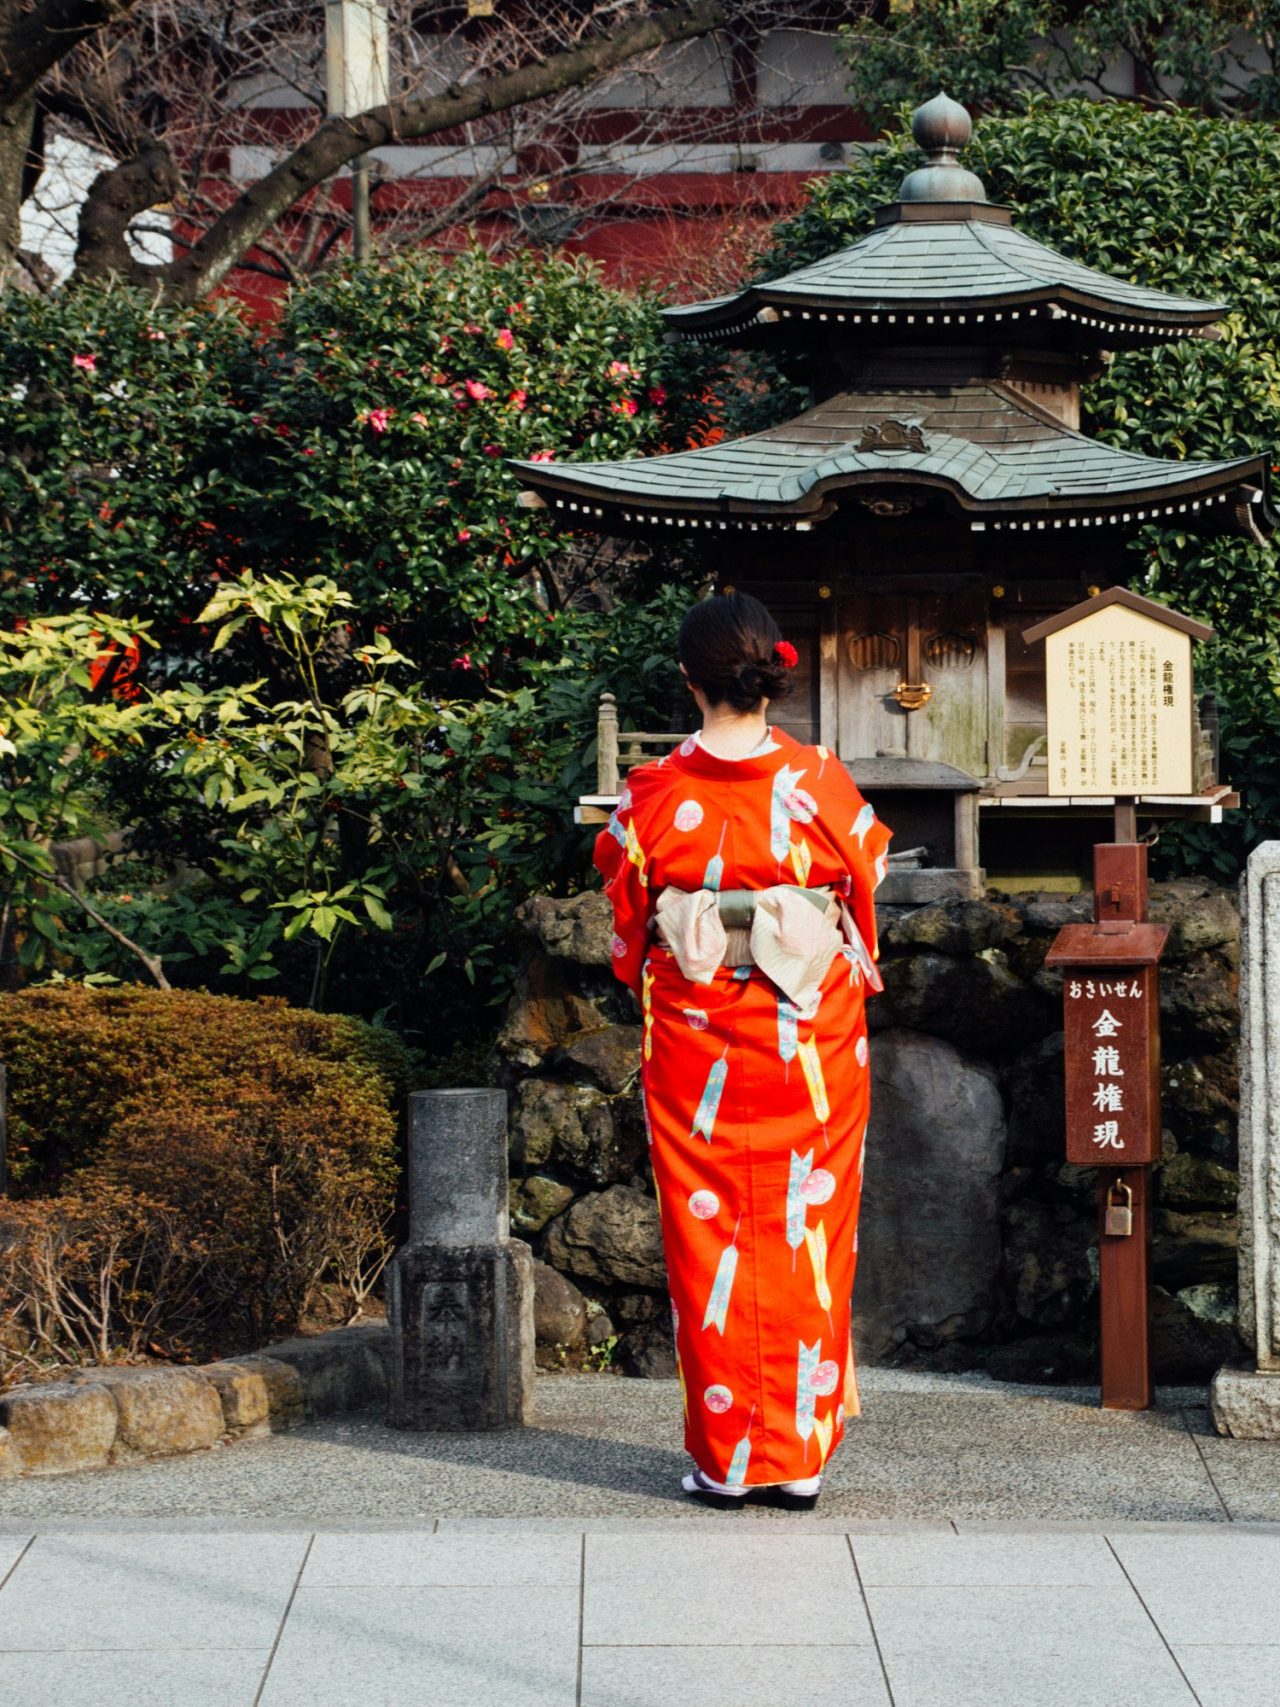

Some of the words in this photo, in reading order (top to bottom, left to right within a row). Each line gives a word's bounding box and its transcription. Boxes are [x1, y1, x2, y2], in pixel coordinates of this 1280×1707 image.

[1163, 660, 1174, 707] 金龍権現
[1069, 980, 1143, 999] おさいせん
[1091, 1009, 1125, 1149] 金龍権現
[426, 1286, 468, 1369] 奉納
